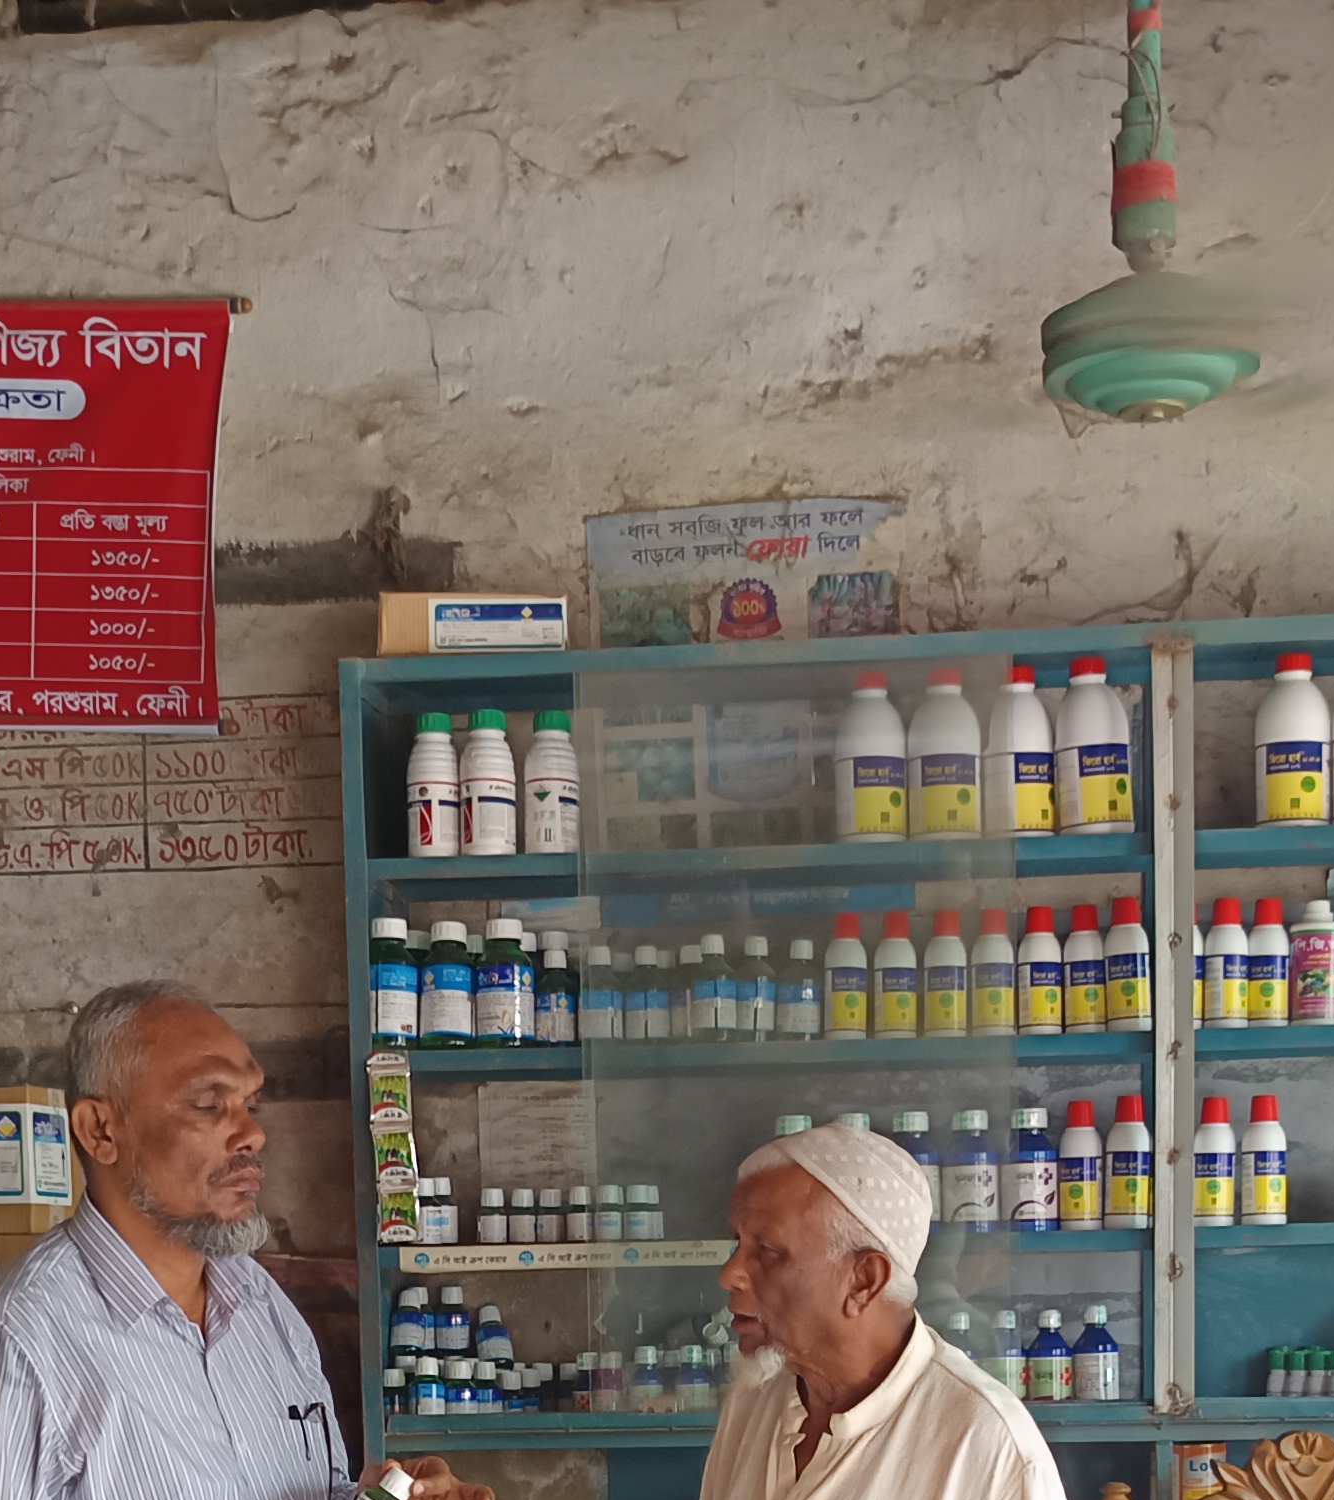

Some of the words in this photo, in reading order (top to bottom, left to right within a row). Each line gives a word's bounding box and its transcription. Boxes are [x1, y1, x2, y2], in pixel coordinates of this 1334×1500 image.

[78, 316, 207, 370] বিতান
[59, 509, 96, 531] প্রতি
[100, 513, 130, 531] বস্তা
[135, 515, 168, 537] মূল্য
[91, 548, 160, 569] ১৩৫০/-
[90, 583, 159, 604] ১৩৫০/-
[89, 618, 155, 639] ১০০০/-
[89, 653, 155, 674] ১০৫০/-
